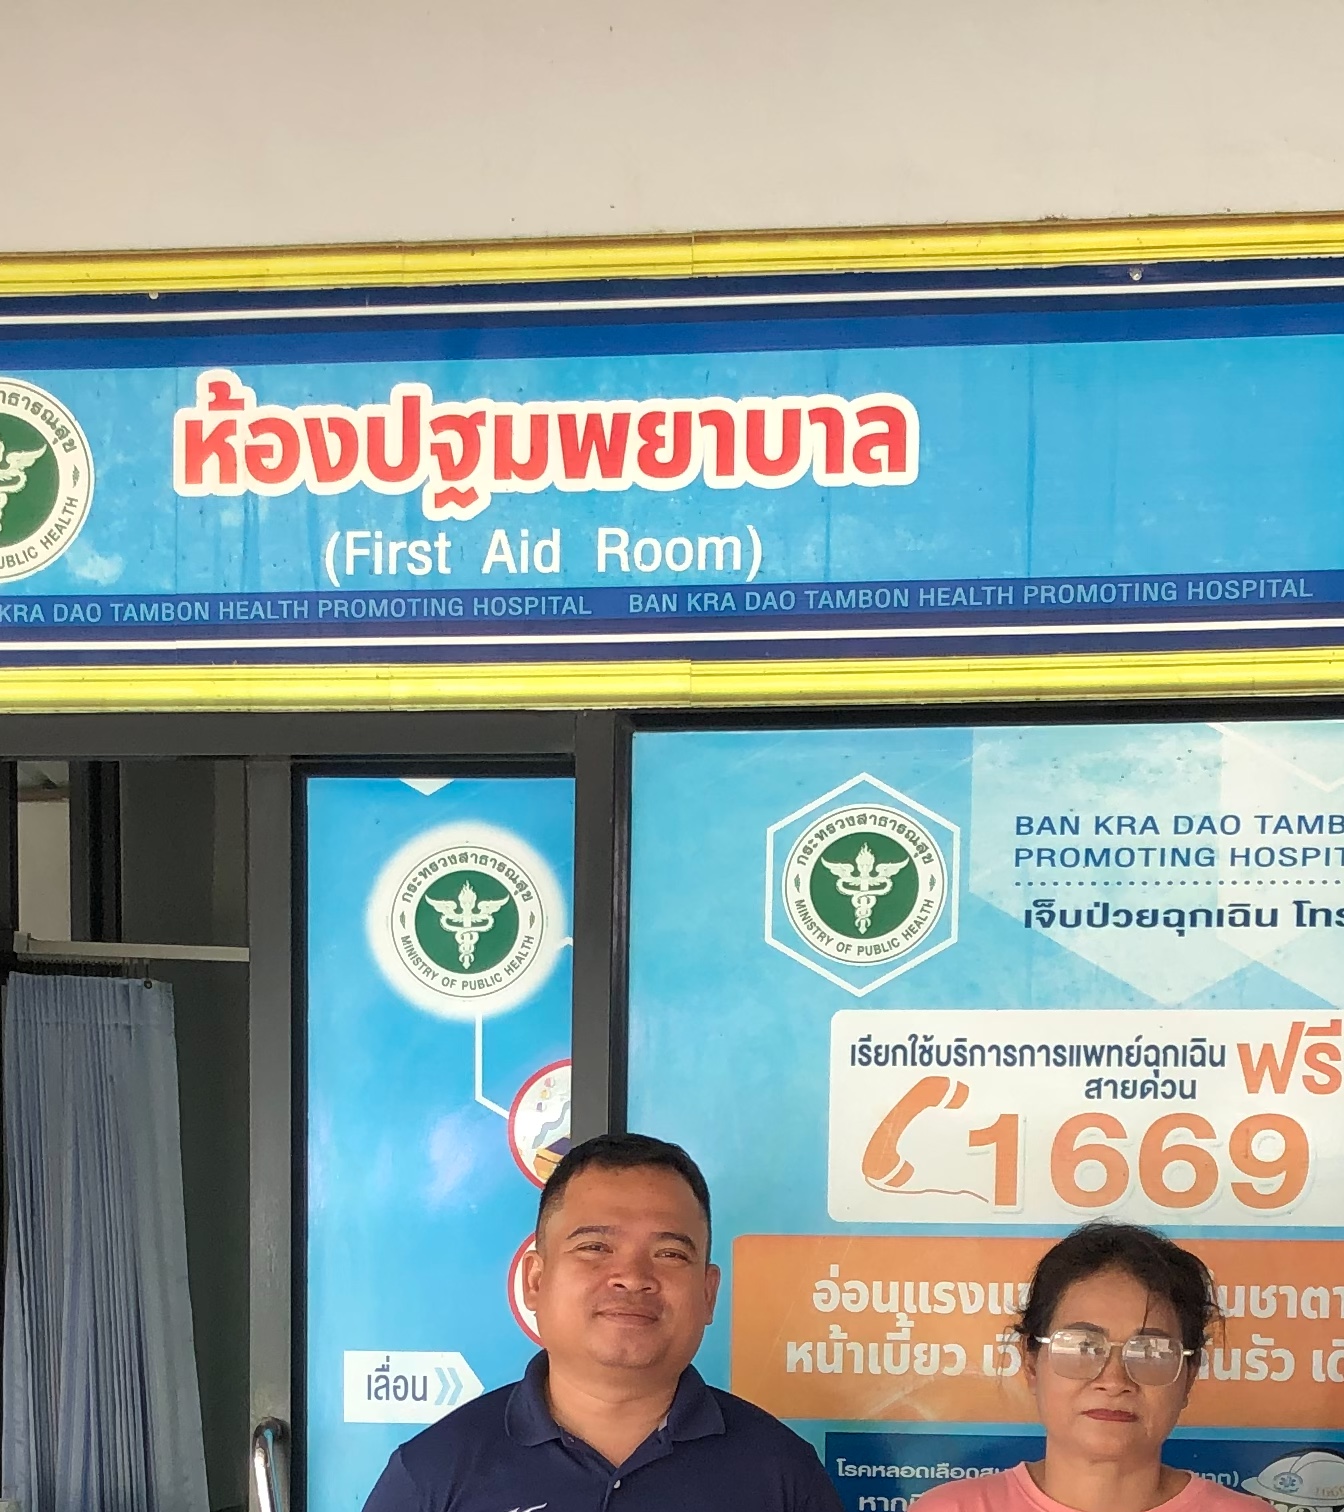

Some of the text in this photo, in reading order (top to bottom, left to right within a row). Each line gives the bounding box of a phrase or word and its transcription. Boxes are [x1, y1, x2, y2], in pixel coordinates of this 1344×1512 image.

[183, 380, 908, 510] ห้องปฐมพยาบาล
[40, 496, 79, 550] HEALTH
[325, 525, 764, 586] (First Aid Room)
[52, 601, 103, 622] DAO
[110, 599, 211, 622] TAMBON
[218, 598, 307, 620] HEALTH
[317, 596, 464, 619] PROMOTING
[472, 594, 593, 616] HOSPITAL
[628, 577, 1314, 613] BAN KRA DAO TAMBON HEALTH PROMOTING HOSPITAL
[796, 813, 935, 867] กระทรวงสาธารณสุข
[1015, 815, 1081, 836] BAN
[1093, 815, 1160, 835] KRA
[1171, 814, 1242, 836] DAO
[401, 851, 534, 904] กระทรวงสาธารณสุข
[1014, 846, 1216, 868] PROMOTING
[794, 898, 935, 956] MINISTRY OF PUBLIC HEALTH
[1024, 899, 1278, 937] เจ็บป่วยฉุกเฉิน
[400, 935, 535, 991] MINISTRY OF PUBLIC HEALTH
[850, 1018, 1344, 1096] เรียกใช้บริการการแพทย์ฉุกเฉิน ฟรี
[1083, 1072, 1197, 1101] สายด่วน
[968, 1111, 1312, 1210] 1669
[786, 1312, 967, 1377] หน้าเบี้ยว
[366, 1355, 428, 1402] เลื่อน
